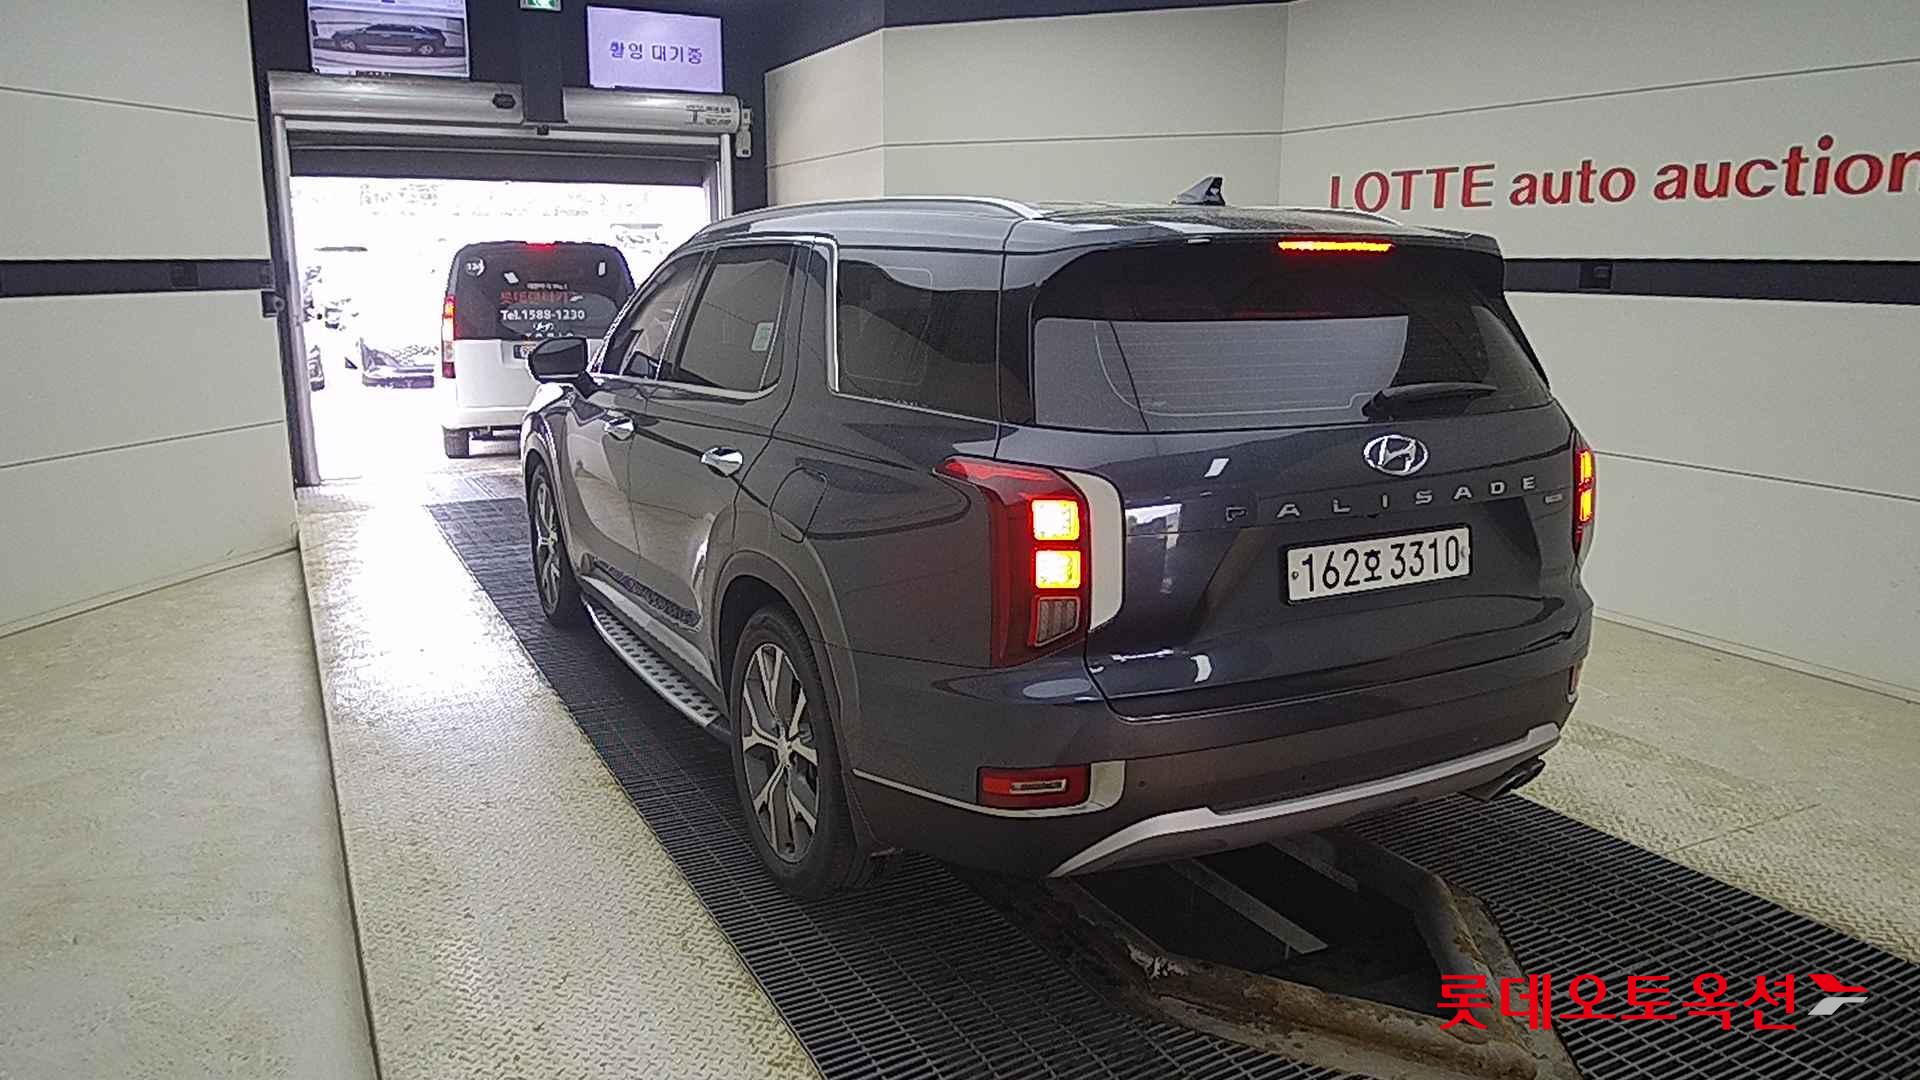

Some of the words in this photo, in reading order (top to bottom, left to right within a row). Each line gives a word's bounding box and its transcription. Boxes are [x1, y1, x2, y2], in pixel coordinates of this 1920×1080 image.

[1330, 164, 1495, 213] LOTTE
[1509, 160, 1635, 206] auto
[1653, 134, 1920, 200] auction
[1225, 477, 1535, 522] PALISADE
